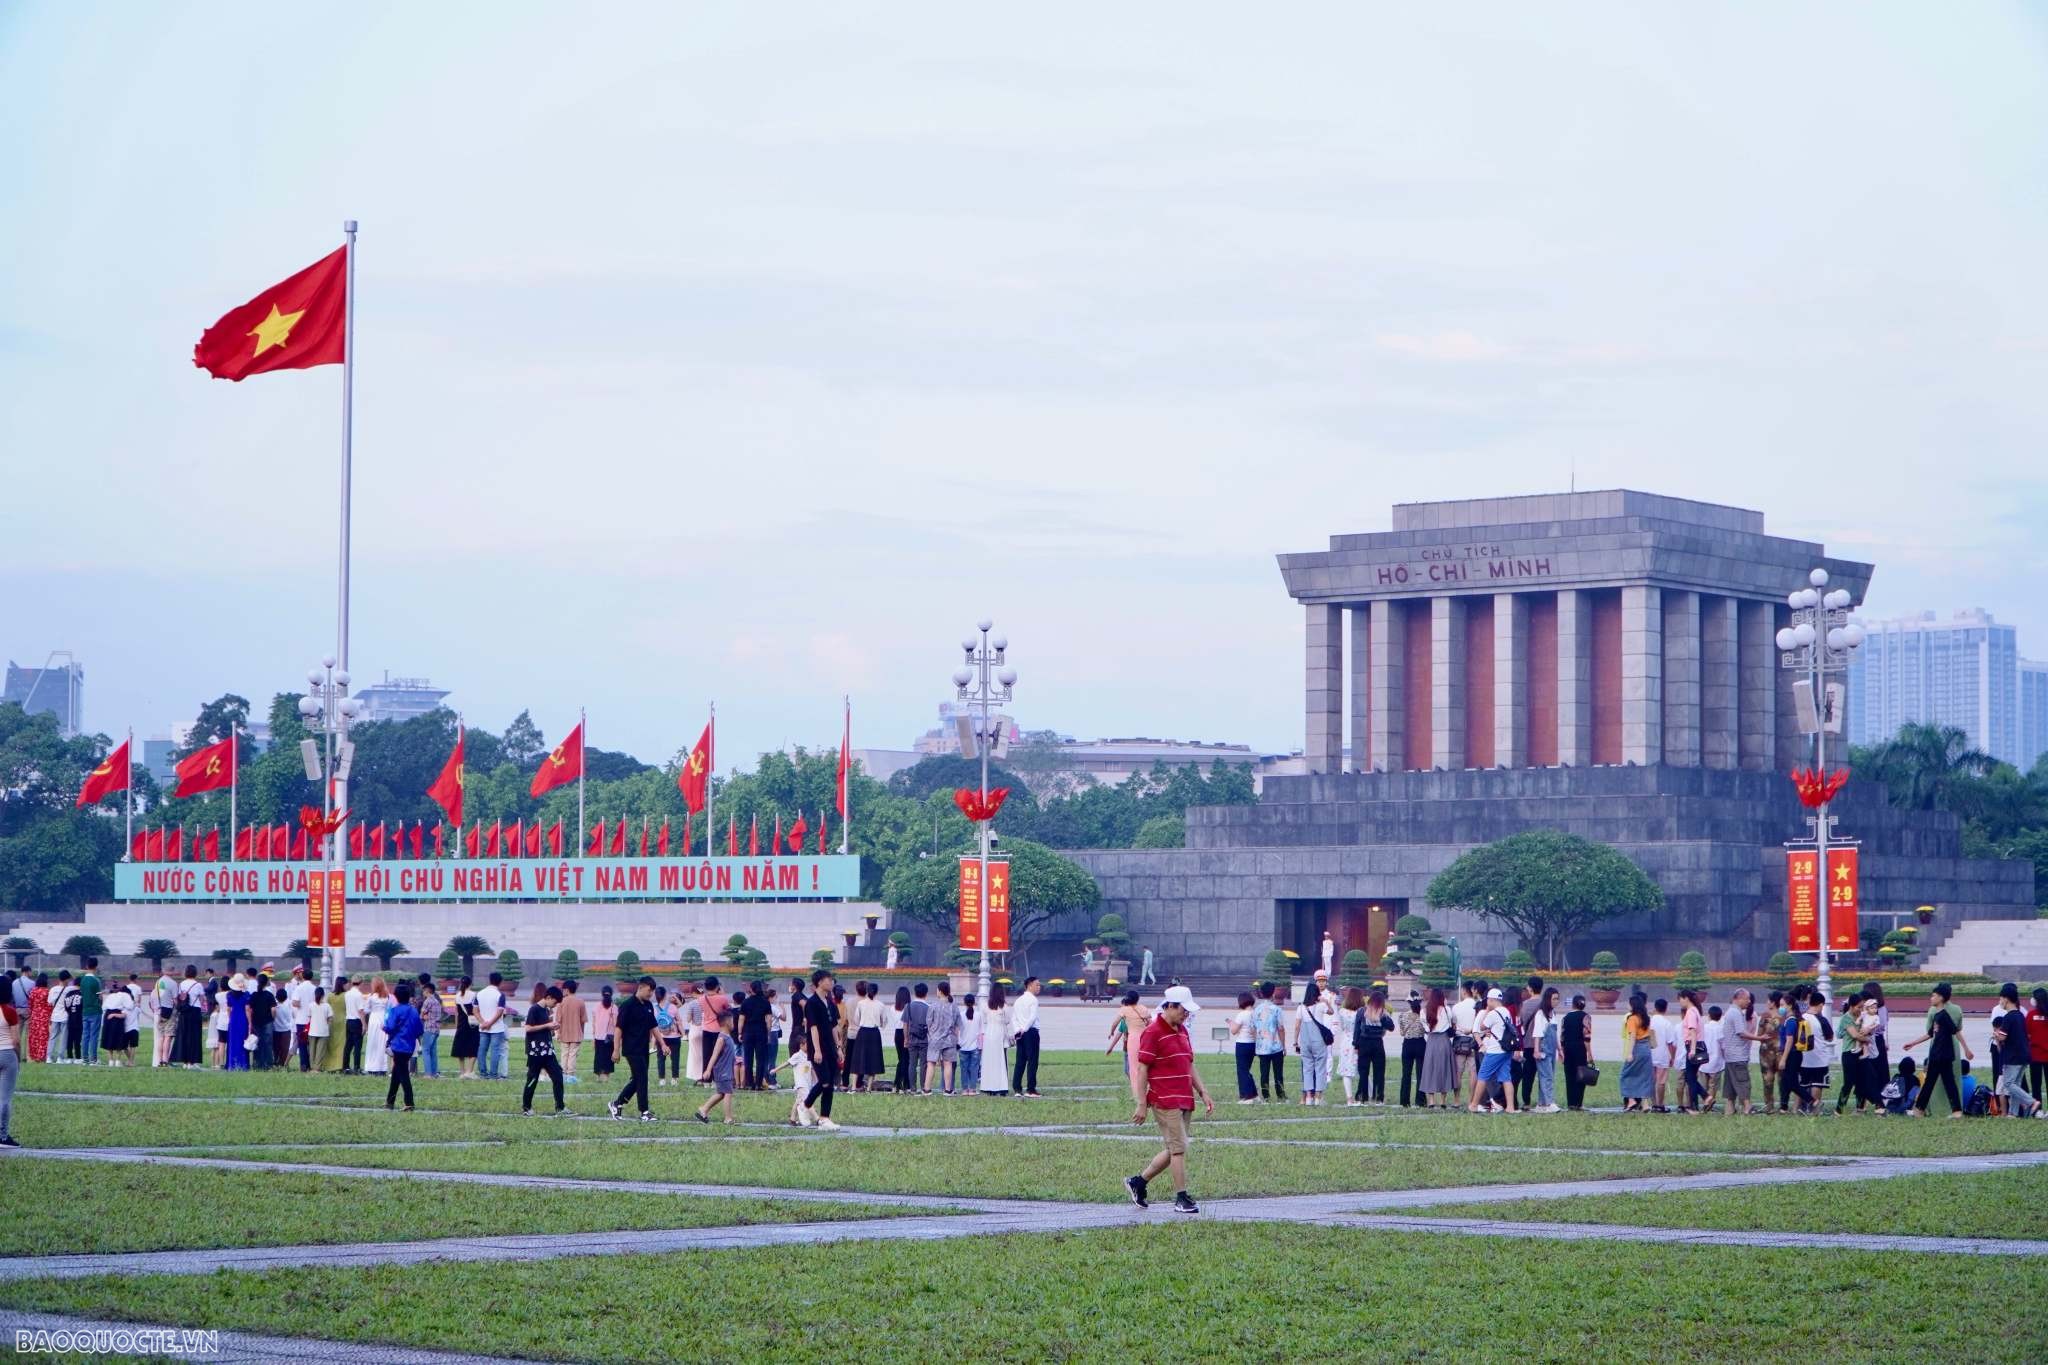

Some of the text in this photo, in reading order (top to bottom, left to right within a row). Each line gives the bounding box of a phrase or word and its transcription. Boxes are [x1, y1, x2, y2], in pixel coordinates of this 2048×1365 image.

[1794, 861, 1813, 875] 2-9
[143, 866, 196, 893] NƯỚC
[204, 865, 259, 897] CỘNG
[268, 865, 308, 893] HÒA
[354, 864, 390, 897] HỘI
[400, 861, 444, 892] CHỦ
[454, 863, 523, 892] NGHĨA
[534, 862, 584, 896] VIỆT
[595, 866, 649, 891] NAM
[659, 861, 732, 891] MUÔN
[743, 860, 800, 891] NĂM
[1832, 886, 1853, 901] 2-9
